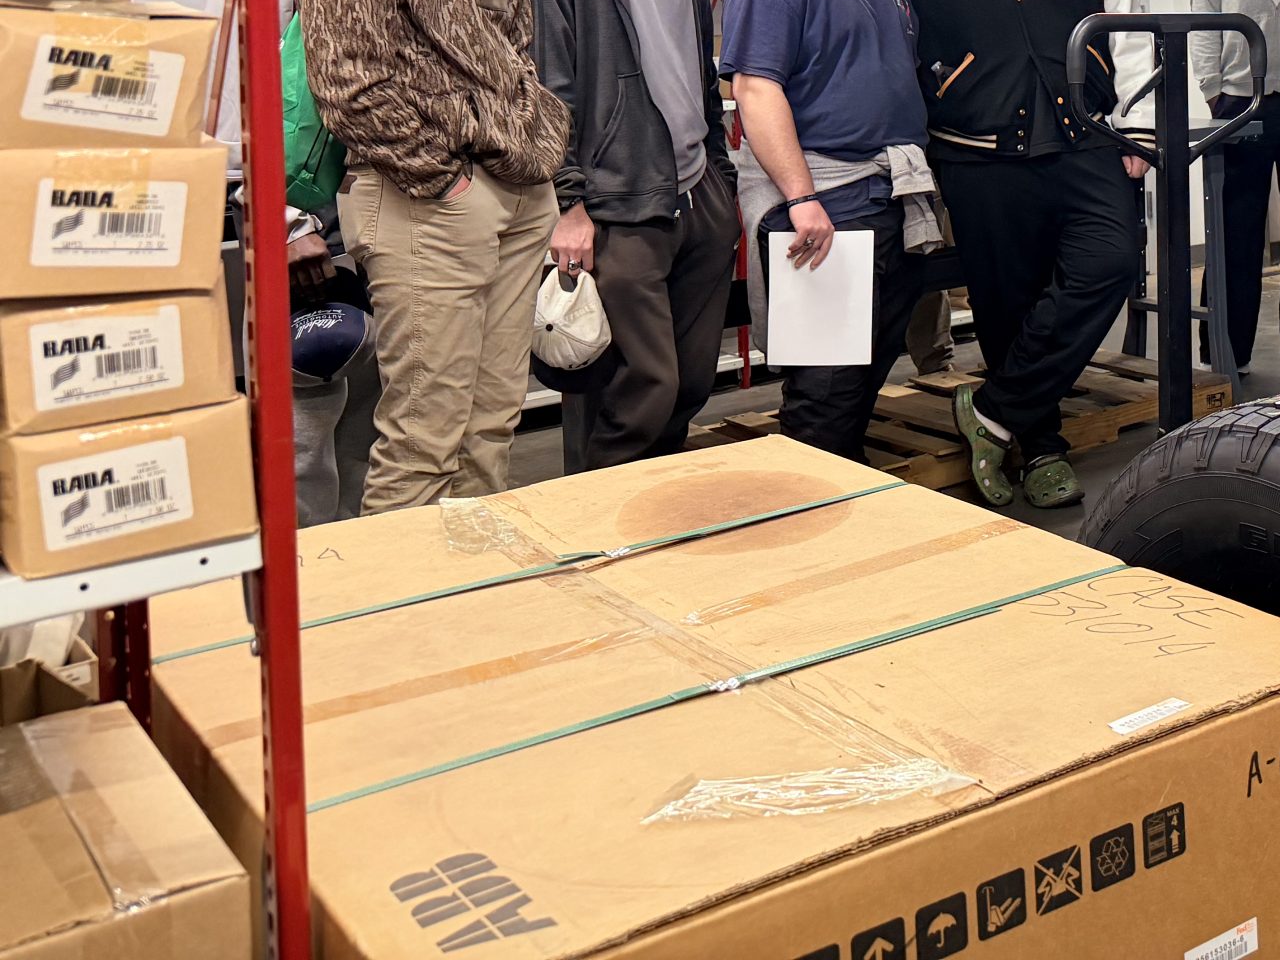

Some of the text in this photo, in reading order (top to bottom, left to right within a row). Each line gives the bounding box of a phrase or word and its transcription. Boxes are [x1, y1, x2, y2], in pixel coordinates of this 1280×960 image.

[295, 319, 342, 340] Mitchell
[1087, 575, 1245, 630] CASE
[1171, 814, 1178, 826] 4
